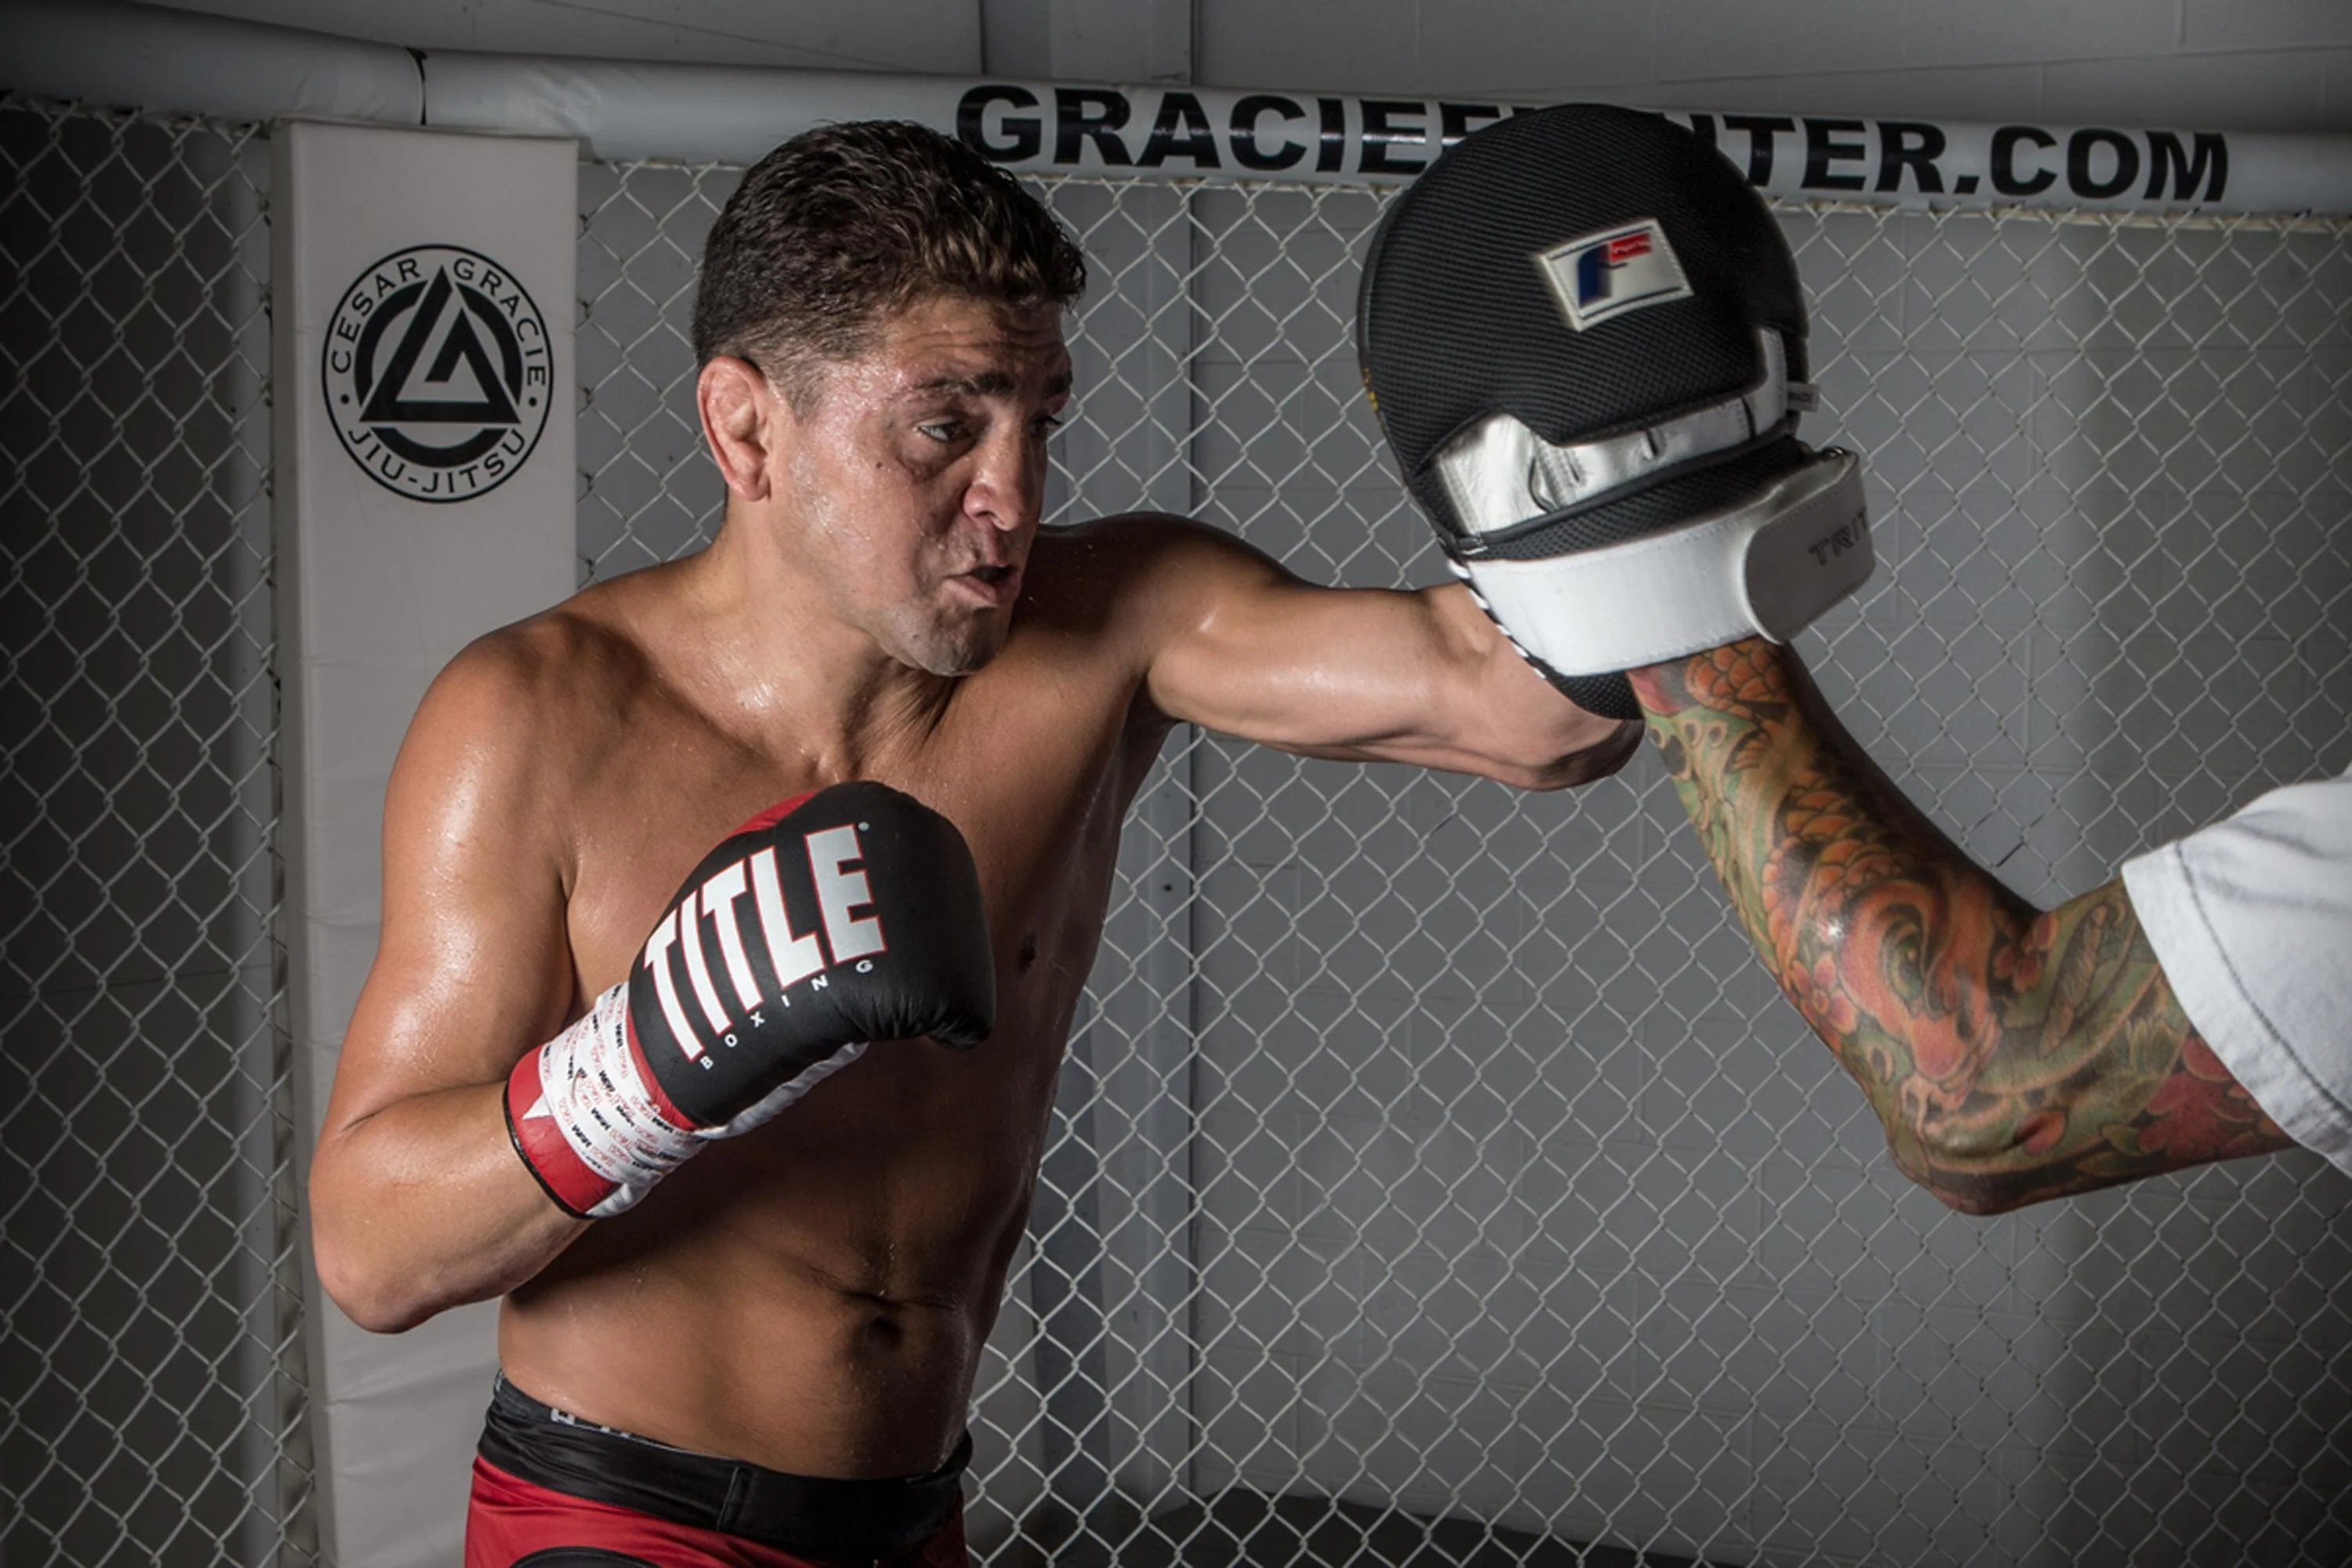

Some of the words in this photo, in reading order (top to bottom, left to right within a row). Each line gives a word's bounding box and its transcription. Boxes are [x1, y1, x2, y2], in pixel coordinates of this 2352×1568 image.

[331, 258, 421, 374] CESAR
[453, 257, 545, 387] GRACIE
[347, 428, 525, 493] JIU-JITSU
[643, 823, 888, 1063] TITLE
[700, 959, 873, 1069] BOXING
